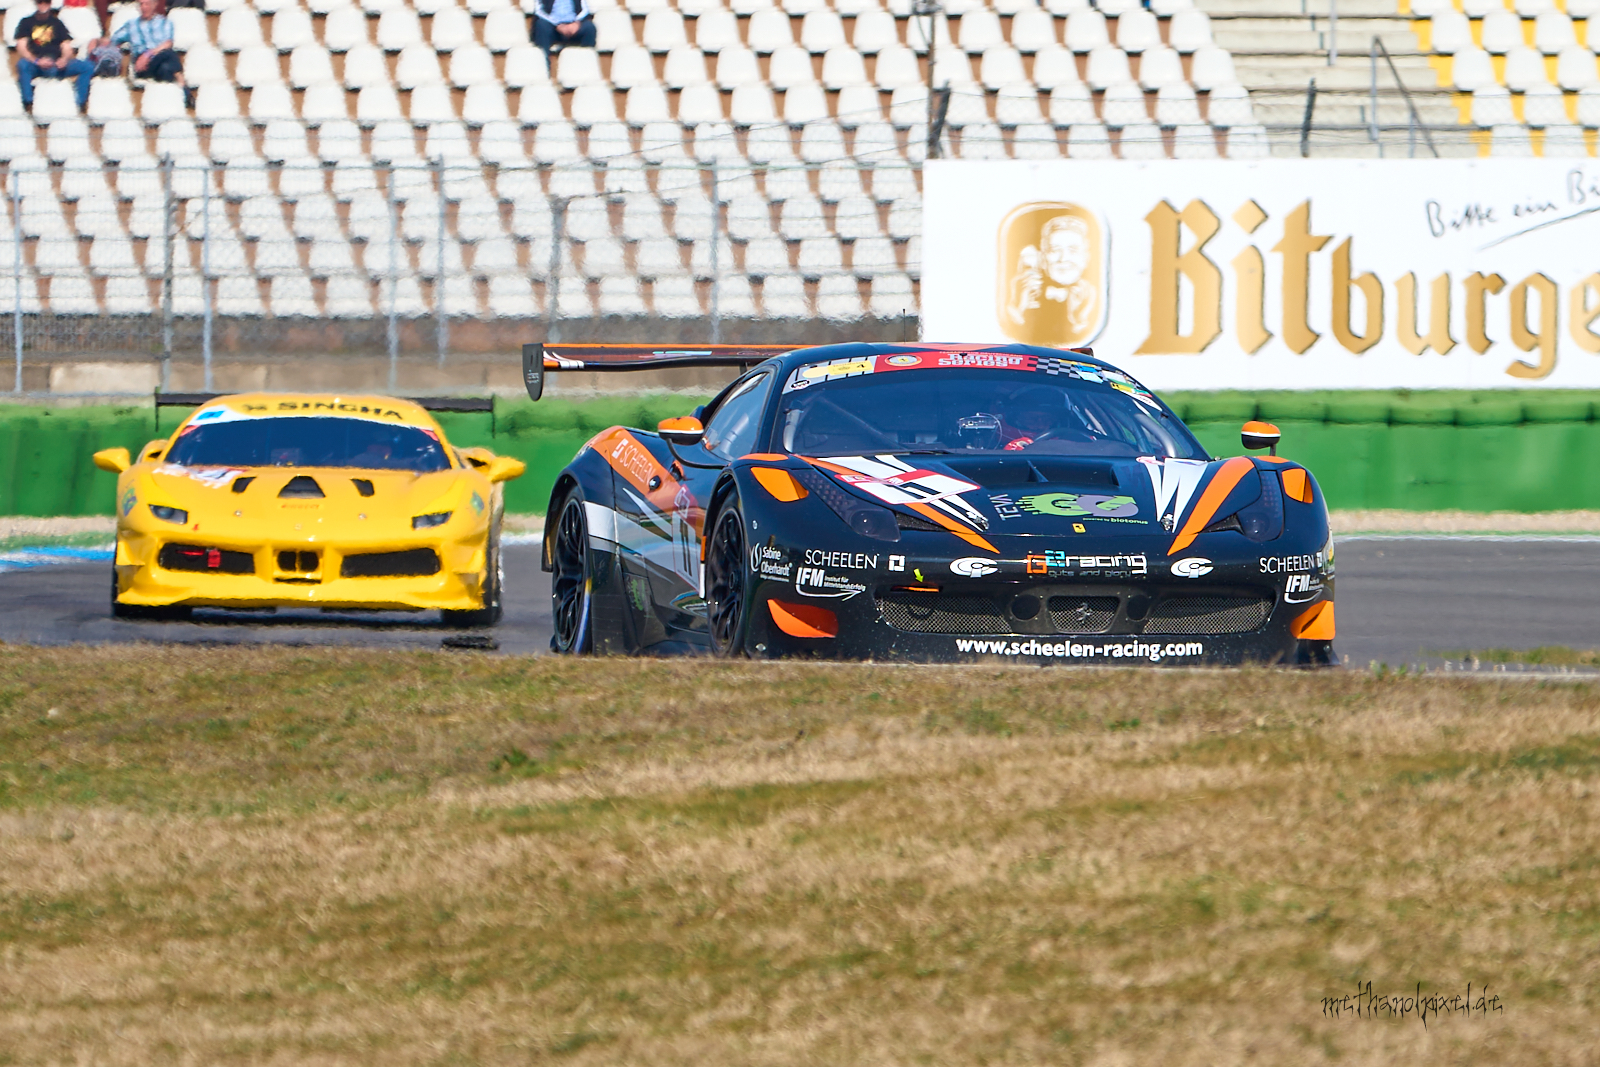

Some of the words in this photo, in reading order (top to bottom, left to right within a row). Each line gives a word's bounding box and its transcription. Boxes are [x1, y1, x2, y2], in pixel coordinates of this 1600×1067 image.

[1426, 199, 1497, 238] Bitte
[1513, 196, 1558, 217] ein
[938, 357, 1009, 367] Series
[947, 353, 1023, 365] Racing
[277, 402, 403, 420] SINGHA
[620, 444, 657, 486] SCHEELEN
[1111, 517, 1149, 525] biotonus
[762, 546, 782, 560] Sabine
[805, 549, 878, 569] SCHEELEN
[1259, 555, 1315, 573] SCHEELEN
[796, 567, 825, 588] IFM
[1285, 575, 1310, 593] IFM
[956, 639, 1203, 661] www.scheelen-racing.com
